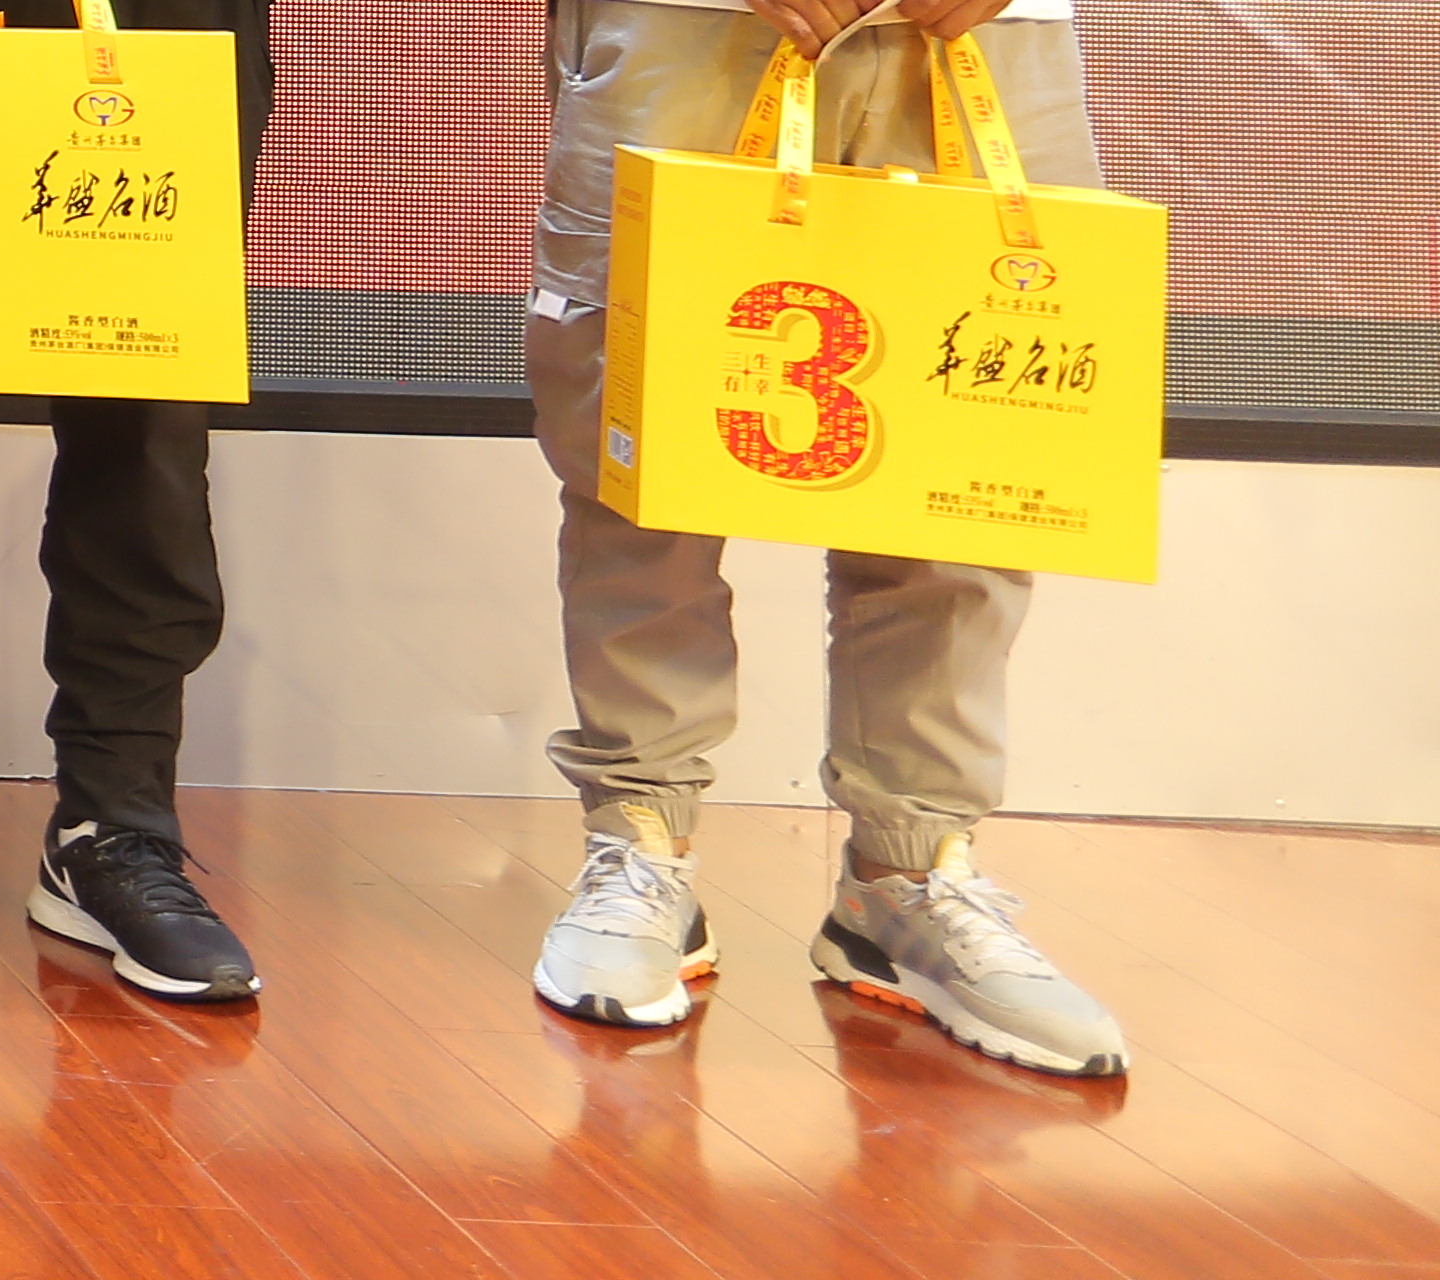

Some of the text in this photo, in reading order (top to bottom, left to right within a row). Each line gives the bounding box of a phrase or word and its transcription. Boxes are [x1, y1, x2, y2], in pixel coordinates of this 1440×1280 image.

[46, 228, 174, 242] HUASHENGMINGJIU
[715, 280, 873, 483] 3
[951, 392, 1090, 415] HUASHENGMINGJIU
